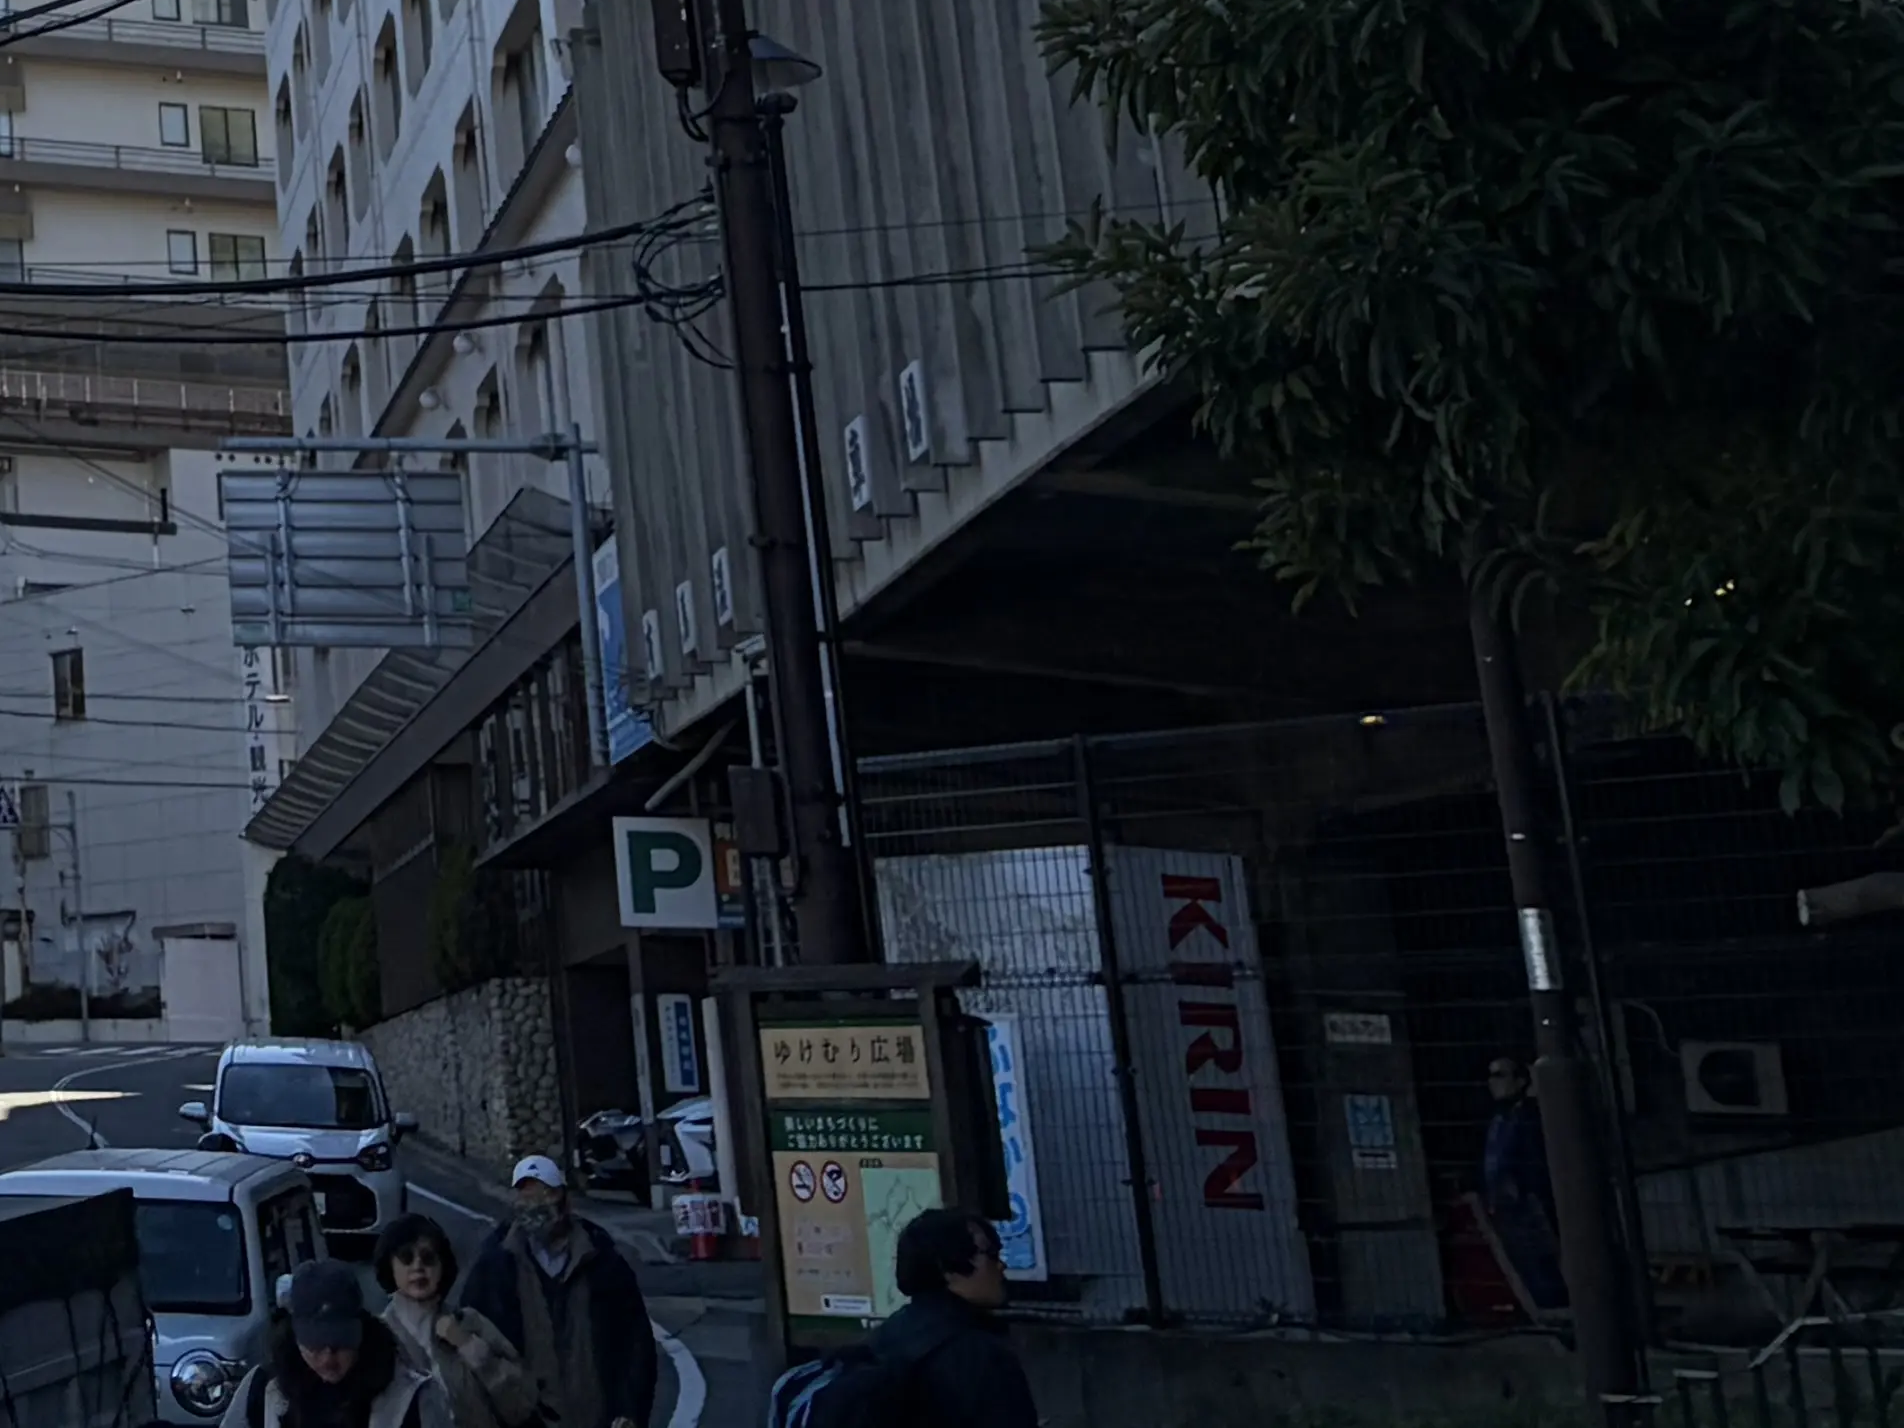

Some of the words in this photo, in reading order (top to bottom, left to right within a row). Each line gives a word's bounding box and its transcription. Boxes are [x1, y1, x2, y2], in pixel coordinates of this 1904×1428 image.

[626, 830, 702, 914] P
[774, 1035, 916, 1065] ゆけむり広場
[1161, 873, 1264, 1210] KIRIN
